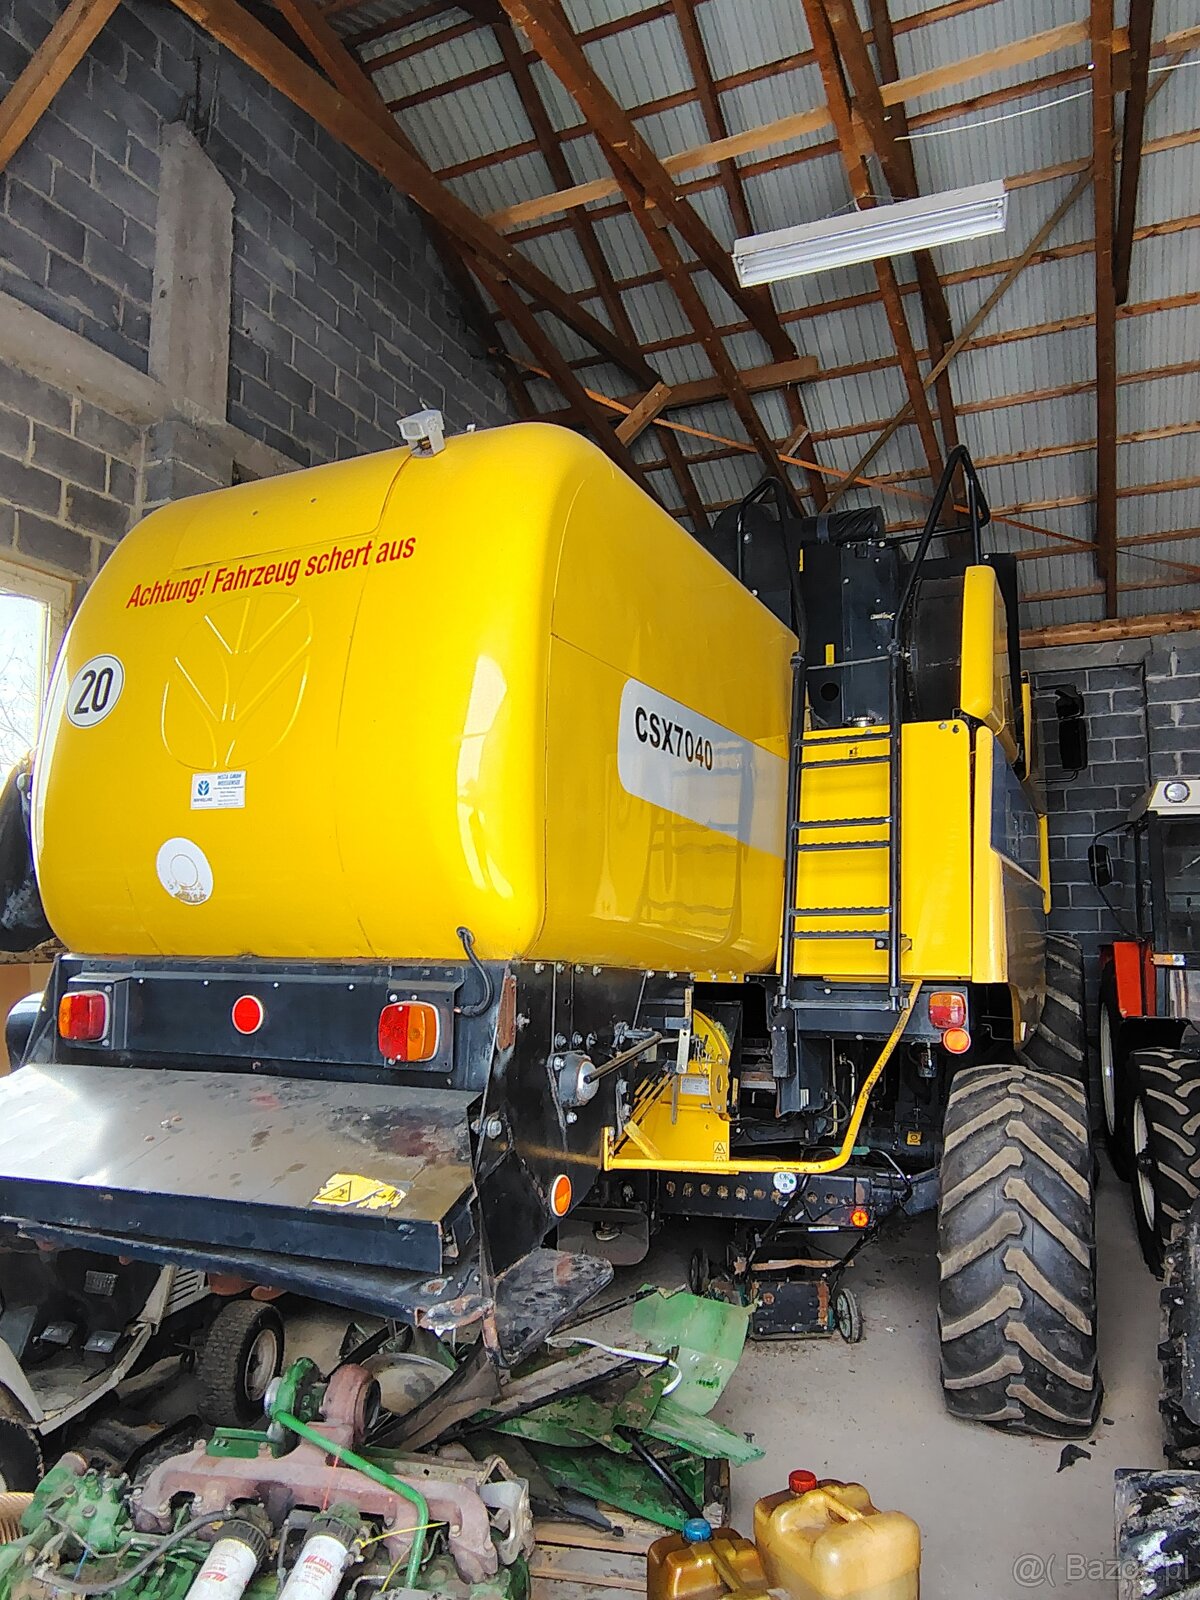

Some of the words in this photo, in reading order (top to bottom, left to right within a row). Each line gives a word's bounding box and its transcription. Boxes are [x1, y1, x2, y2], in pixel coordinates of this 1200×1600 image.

[126, 571, 210, 608] Achtung!
[211, 559, 301, 593] Fahrzeug
[305, 540, 373, 576] schert
[376, 537, 416, 564] aus
[74, 667, 114, 715] 20
[635, 706, 713, 771] CSX7040
